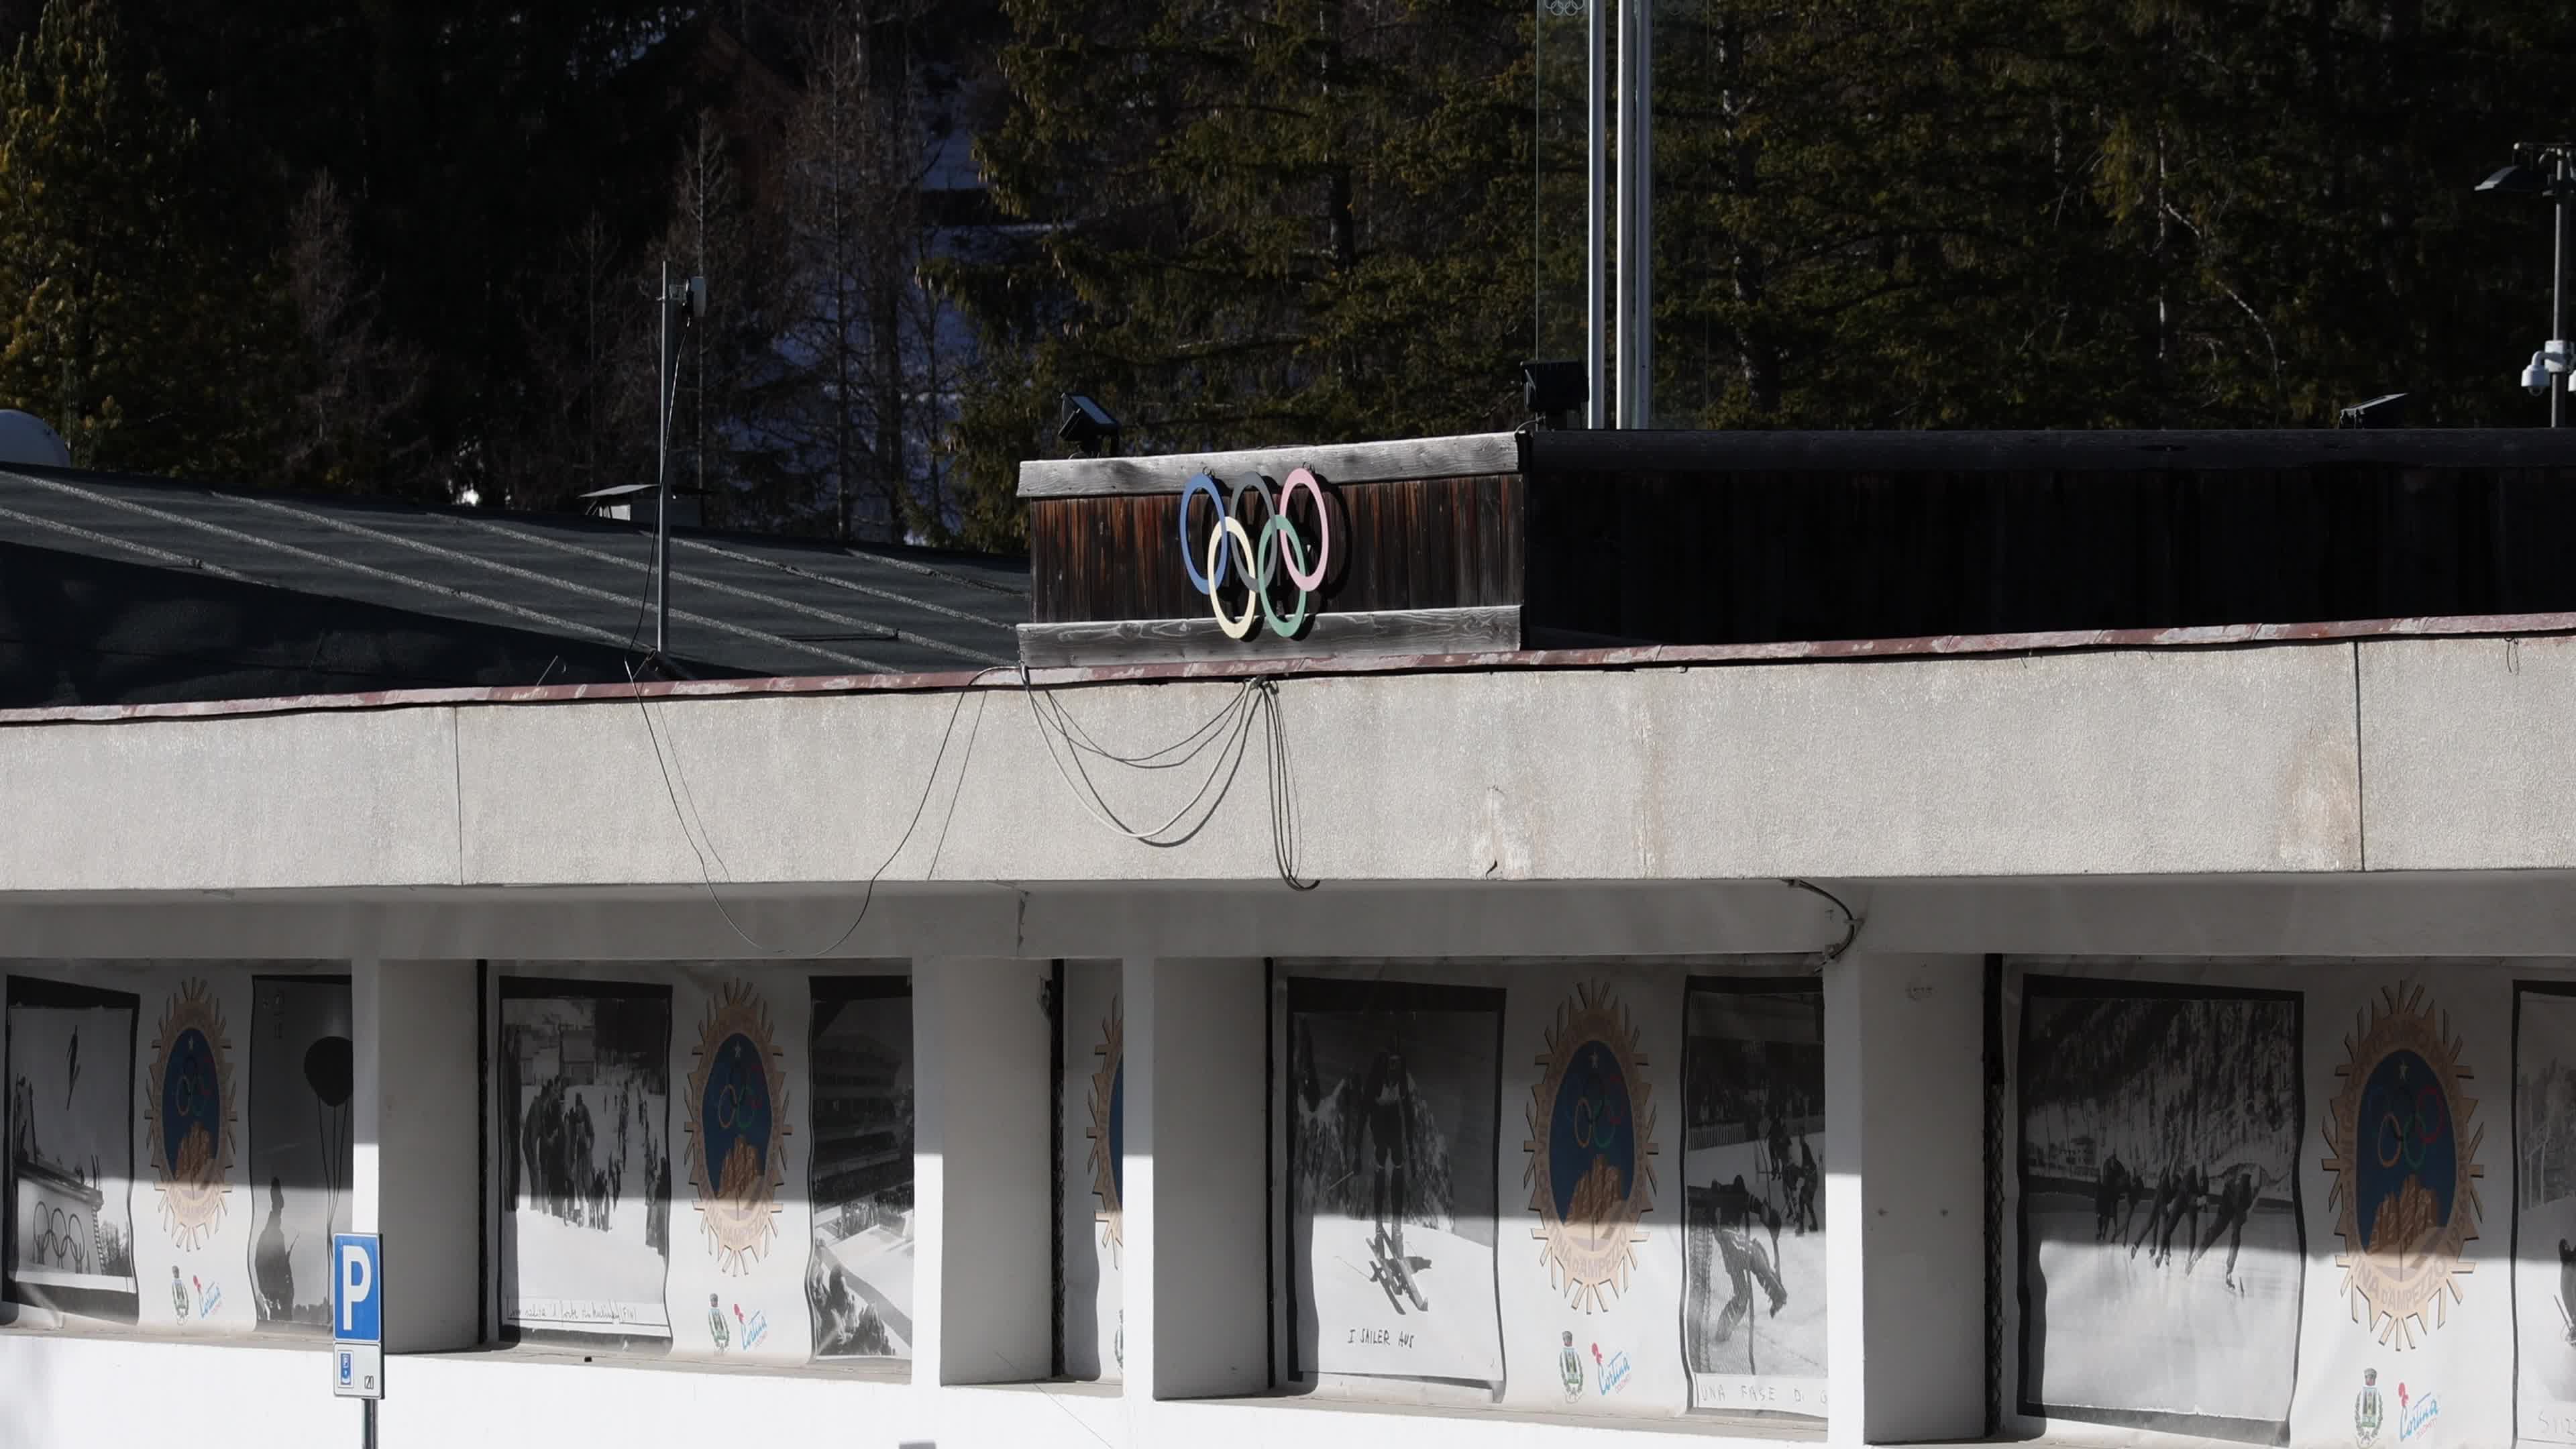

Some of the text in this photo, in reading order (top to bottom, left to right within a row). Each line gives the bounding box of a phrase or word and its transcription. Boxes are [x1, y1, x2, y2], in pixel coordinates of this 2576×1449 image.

[343, 1245, 372, 1331] P
[1360, 1328, 1391, 1346] SAILER
[1598, 1350, 1630, 1395] Cortina
[1701, 1384, 1726, 1401] UNA
[1740, 1385, 1776, 1402] FASE
[2399, 1391, 2438, 1443] Cortina
